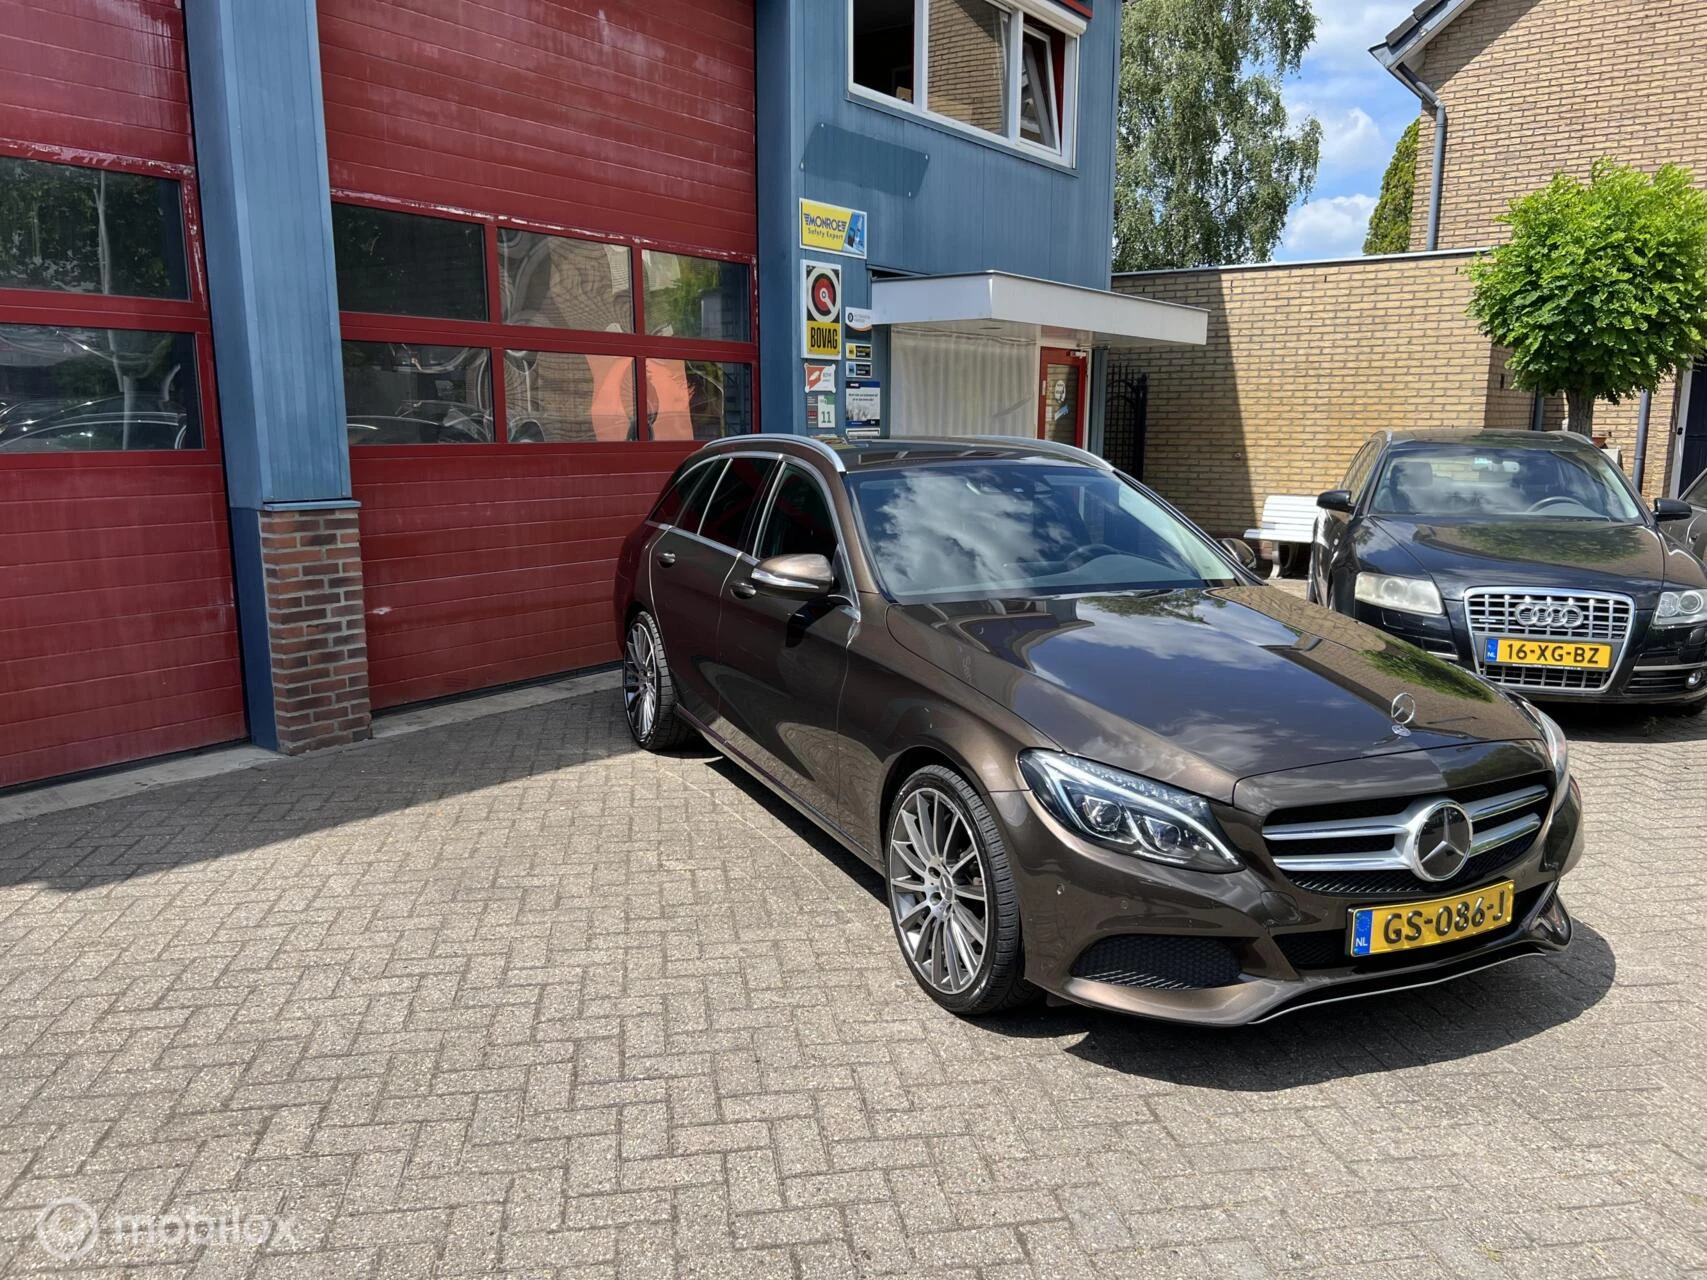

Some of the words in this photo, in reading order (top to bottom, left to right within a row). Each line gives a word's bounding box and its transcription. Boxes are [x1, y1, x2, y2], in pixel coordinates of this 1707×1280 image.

[804, 213, 847, 232] MONROE
[807, 227, 825, 238] Safety
[826, 231, 844, 241] Expert
[810, 326, 838, 350] BOVAG
[821, 410, 832, 424] 11
[1507, 643, 1600, 664] 16-XG-BZ
[1383, 890, 1505, 945] GS-086-J
[1355, 937, 1369, 947] NL
